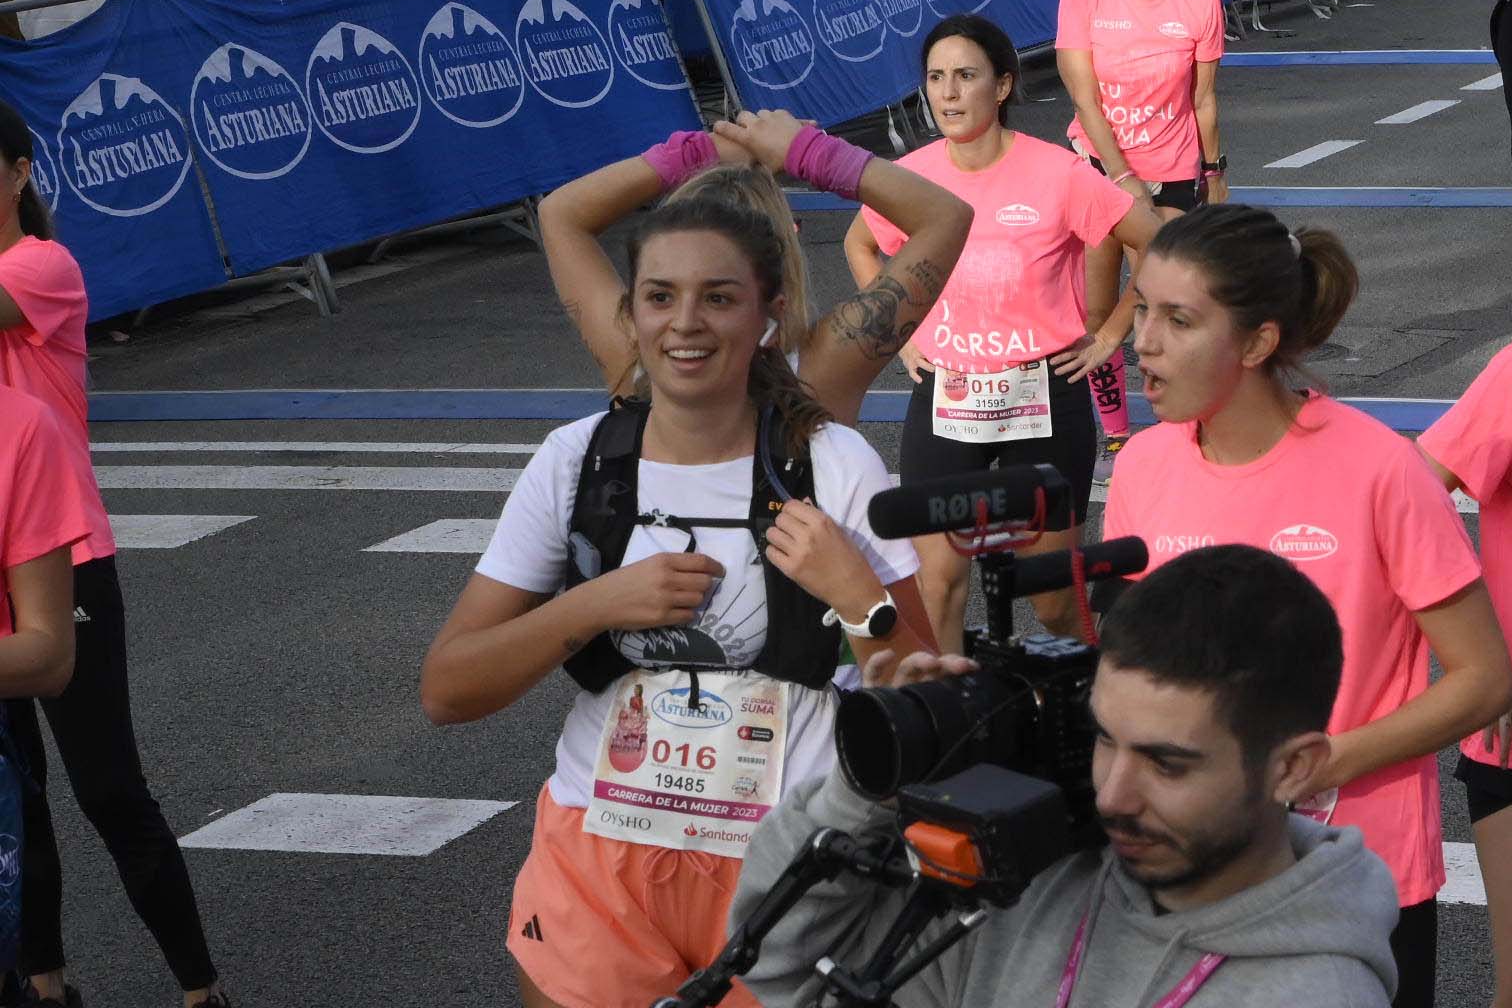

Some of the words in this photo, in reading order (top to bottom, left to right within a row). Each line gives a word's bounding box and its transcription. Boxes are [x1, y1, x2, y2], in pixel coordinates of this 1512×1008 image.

[1094, 18, 1132, 31] OYSHO
[524, 36, 610, 83] ASTURIANA
[429, 53, 521, 102] ASTURIANA
[316, 76, 417, 128] ASTURIANA
[202, 99, 307, 153] ASTURIANA
[1113, 127, 1151, 145] MA
[933, 324, 1041, 357] DORSAL
[971, 379, 1010, 395] 016
[947, 410, 978, 419] CARRERA
[978, 410, 988, 419] DE
[989, 409, 998, 418] LA
[975, 399, 1006, 408] 31595
[739, 703, 776, 717] SUMA
[652, 739, 718, 771] 016
[655, 773, 716, 793] 19485
[607, 787, 654, 806] CARRERA
[655, 796, 671, 807] DE
[673, 798, 688, 809] LA
[690, 800, 730, 816] MUJER
[733, 807, 758, 818] 2023
[600, 810, 652, 832] OYSHO
[700, 826, 752, 844] Santand
